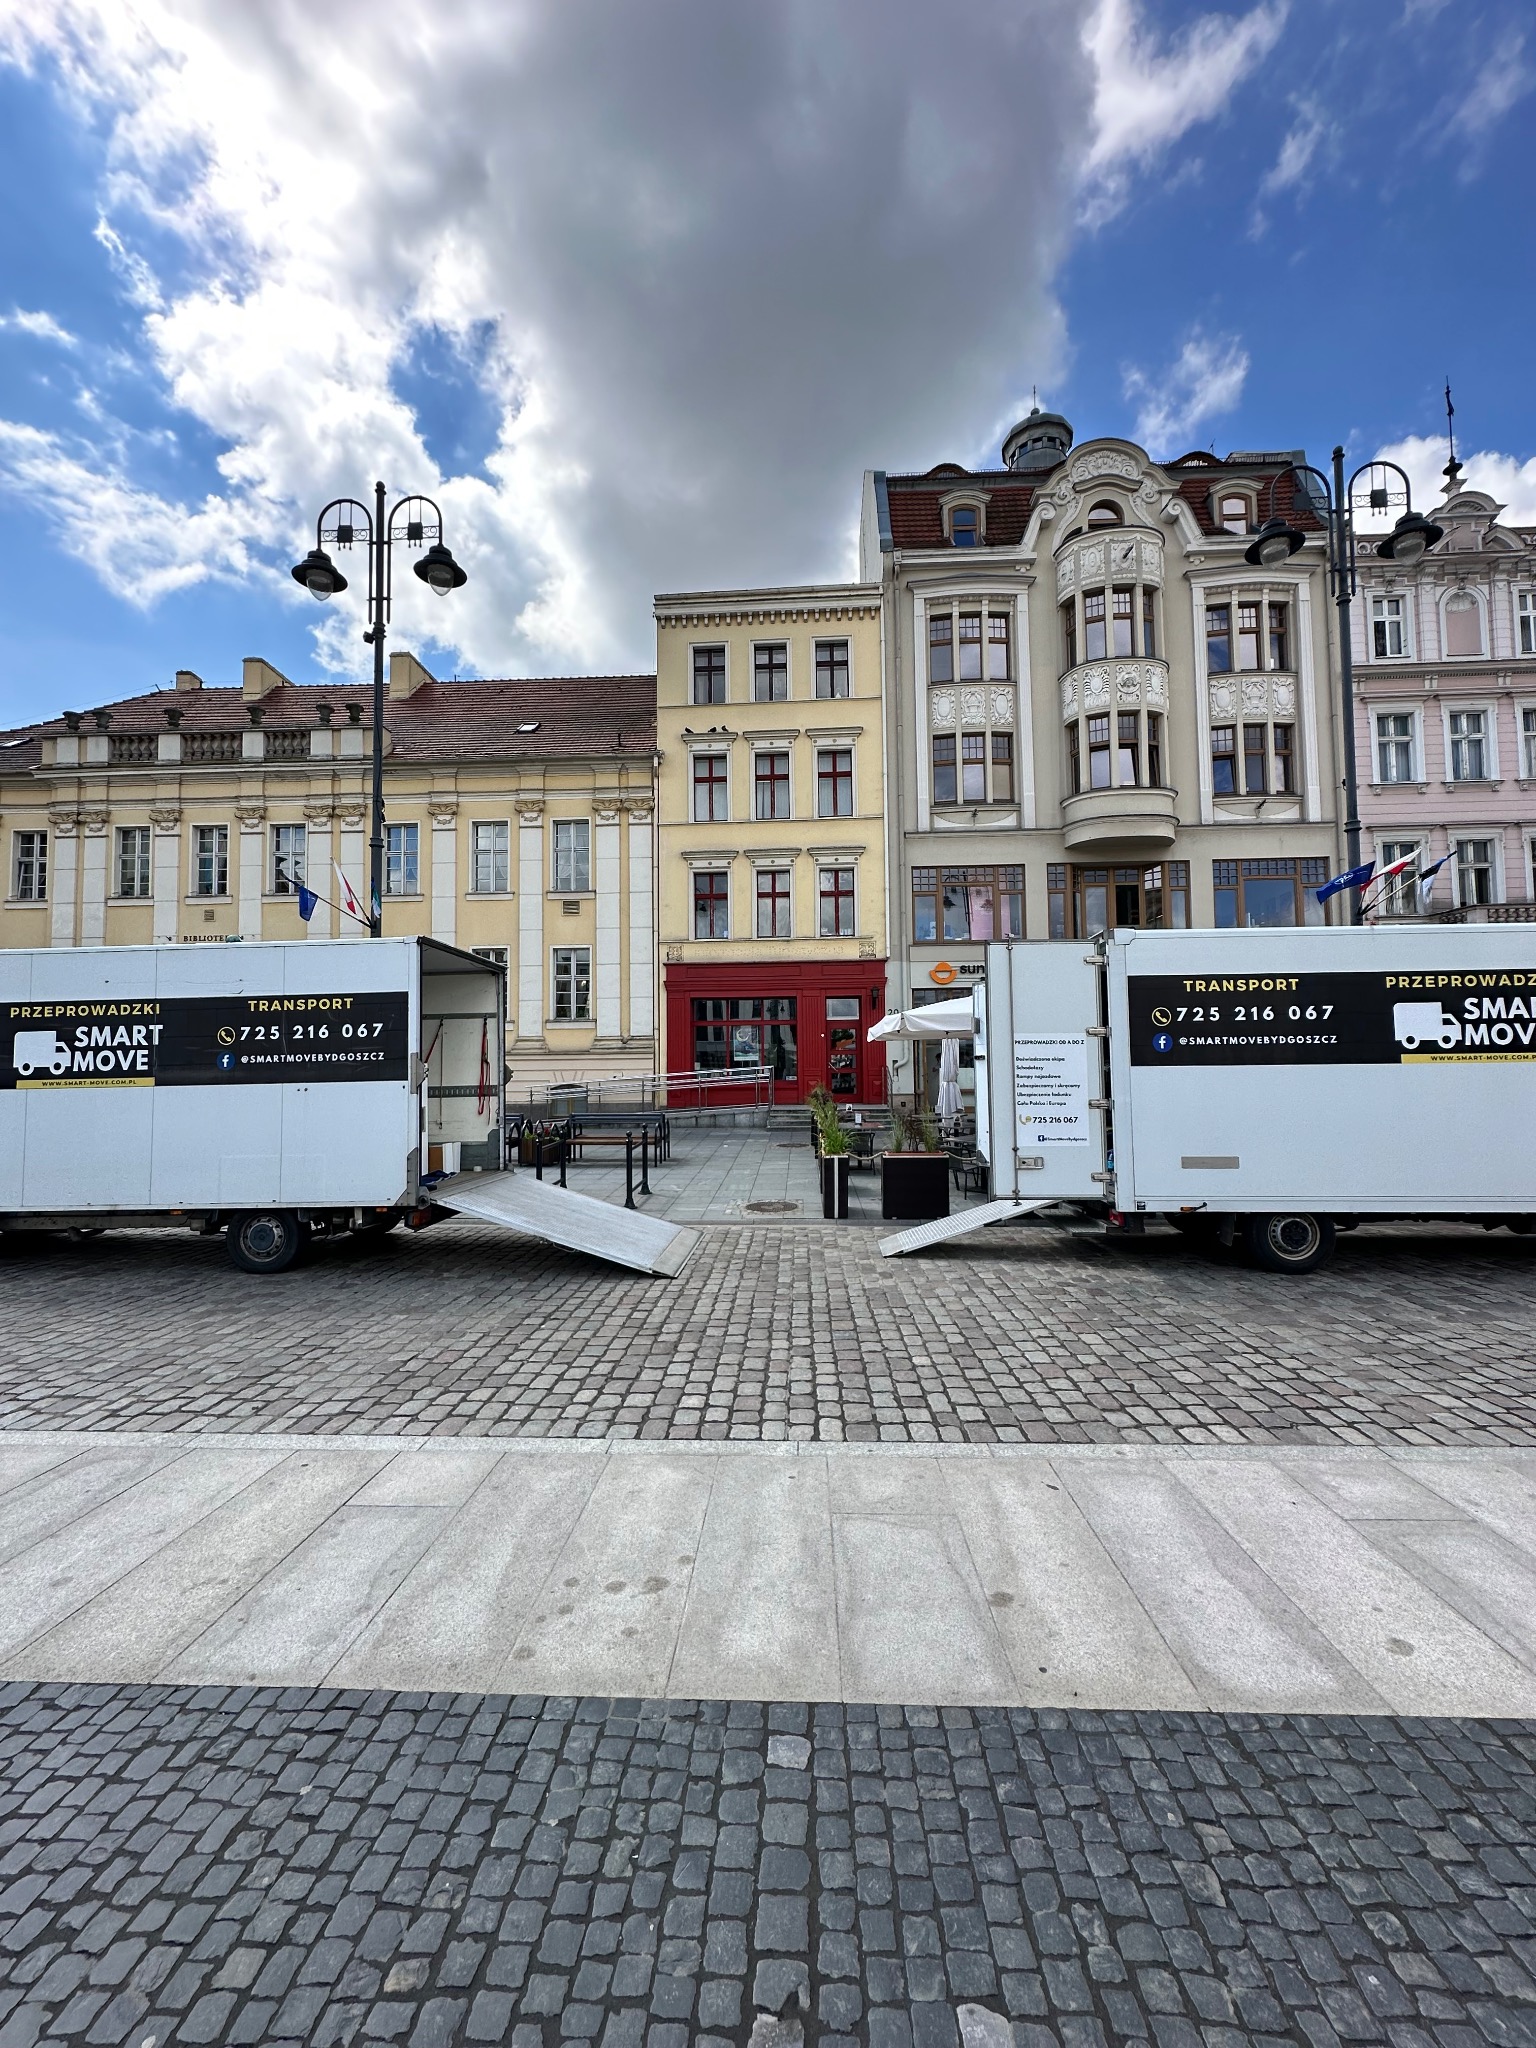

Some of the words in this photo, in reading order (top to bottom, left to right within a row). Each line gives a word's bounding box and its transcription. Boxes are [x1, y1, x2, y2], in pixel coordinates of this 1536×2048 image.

[960, 964, 985, 974] sun
[1183, 978, 1299, 992] TRANSPORT
[10, 1003, 160, 1018] PRZEPROWADZKI
[247, 997, 354, 1012] TRANSPORT
[1463, 996, 1536, 1020] SMA
[1176, 1006, 1220, 1022] 725
[1234, 1006, 1275, 1021] 216
[1288, 1005, 1334, 1020] 067
[74, 1024, 164, 1047] SMART
[239, 1025, 280, 1041] 725
[292, 1024, 329, 1039] 216
[341, 1022, 384, 1038] 067
[1179, 1035, 1338, 1046] @SMARTMOVEBYDGOSZCZ
[72, 1049, 149, 1072] MOVE
[240, 1052, 385, 1064] @SMARTMOVEBYDGOSZCZ
[1032, 1116, 1048, 1124] 725
[1049, 1116, 1062, 1124] 216
[1063, 1116, 1079, 1124] 067
